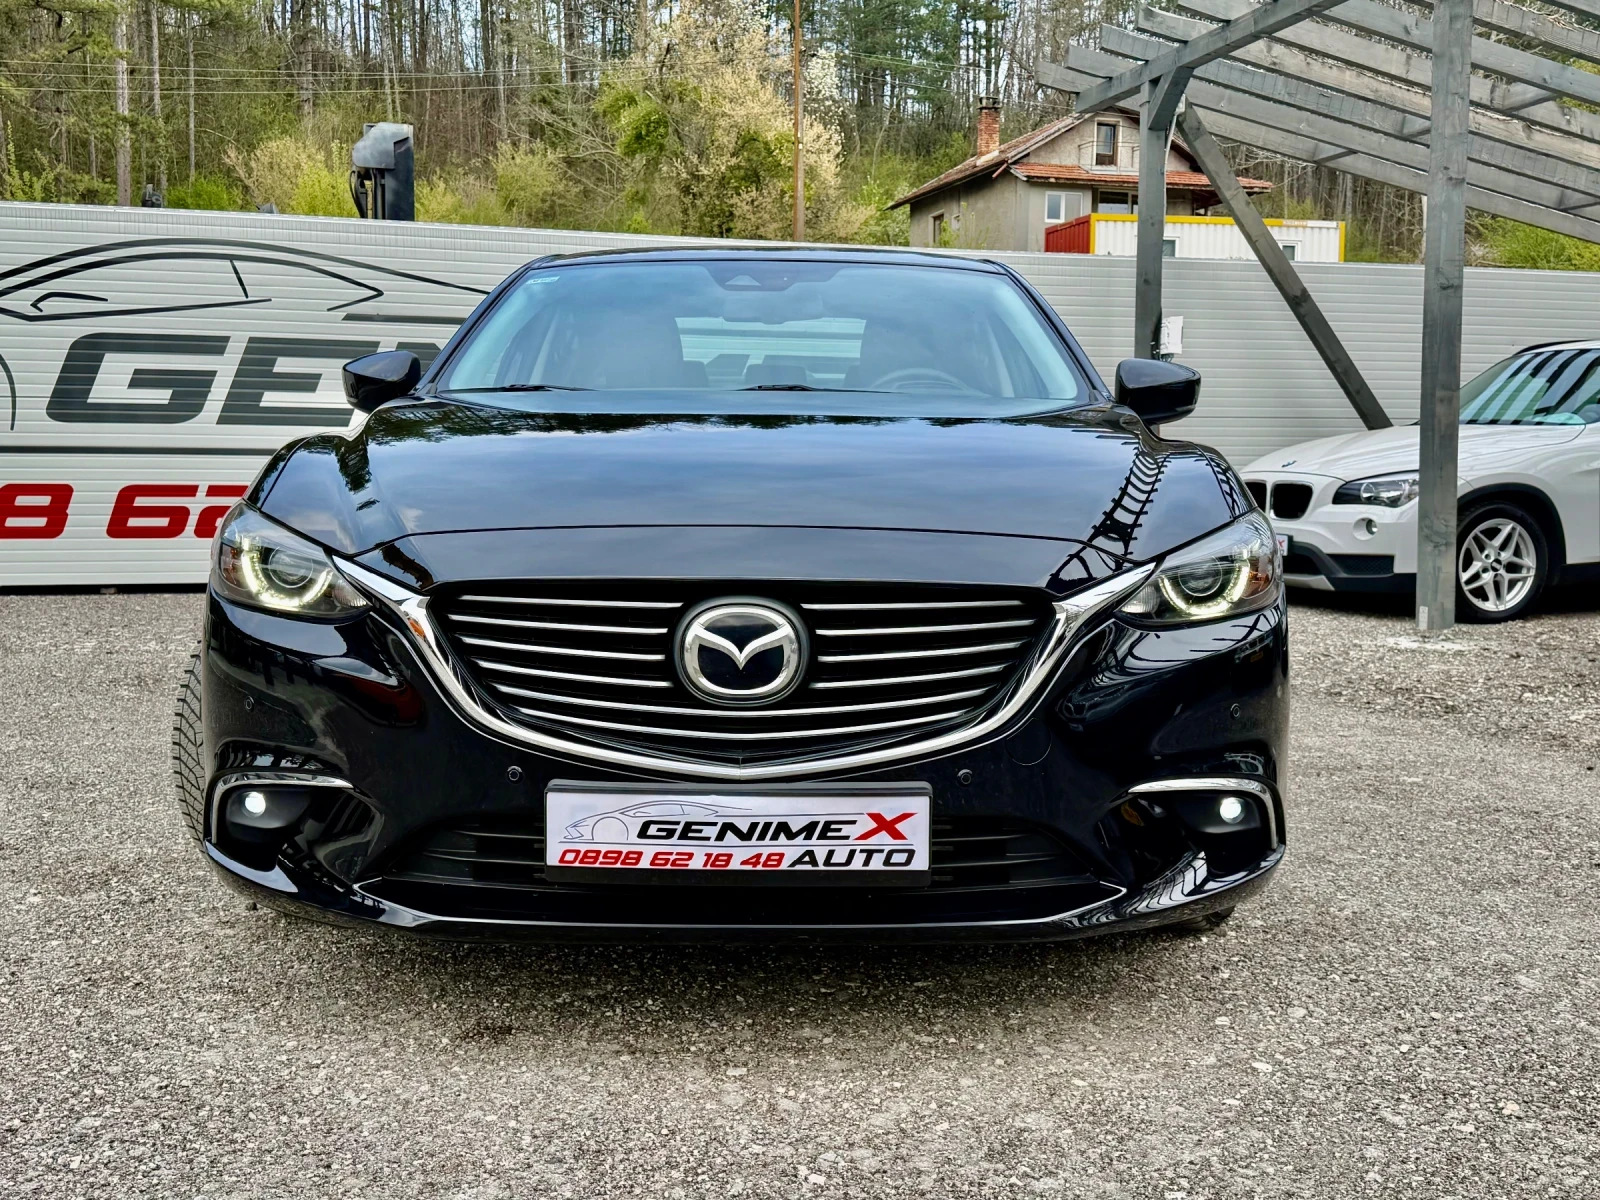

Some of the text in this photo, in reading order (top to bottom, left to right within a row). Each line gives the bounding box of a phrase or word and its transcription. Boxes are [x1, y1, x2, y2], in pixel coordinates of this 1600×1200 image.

[637, 812, 918, 842] GENIMEX
[558, 848, 916, 868] 0898 62 18 48 AUTO
